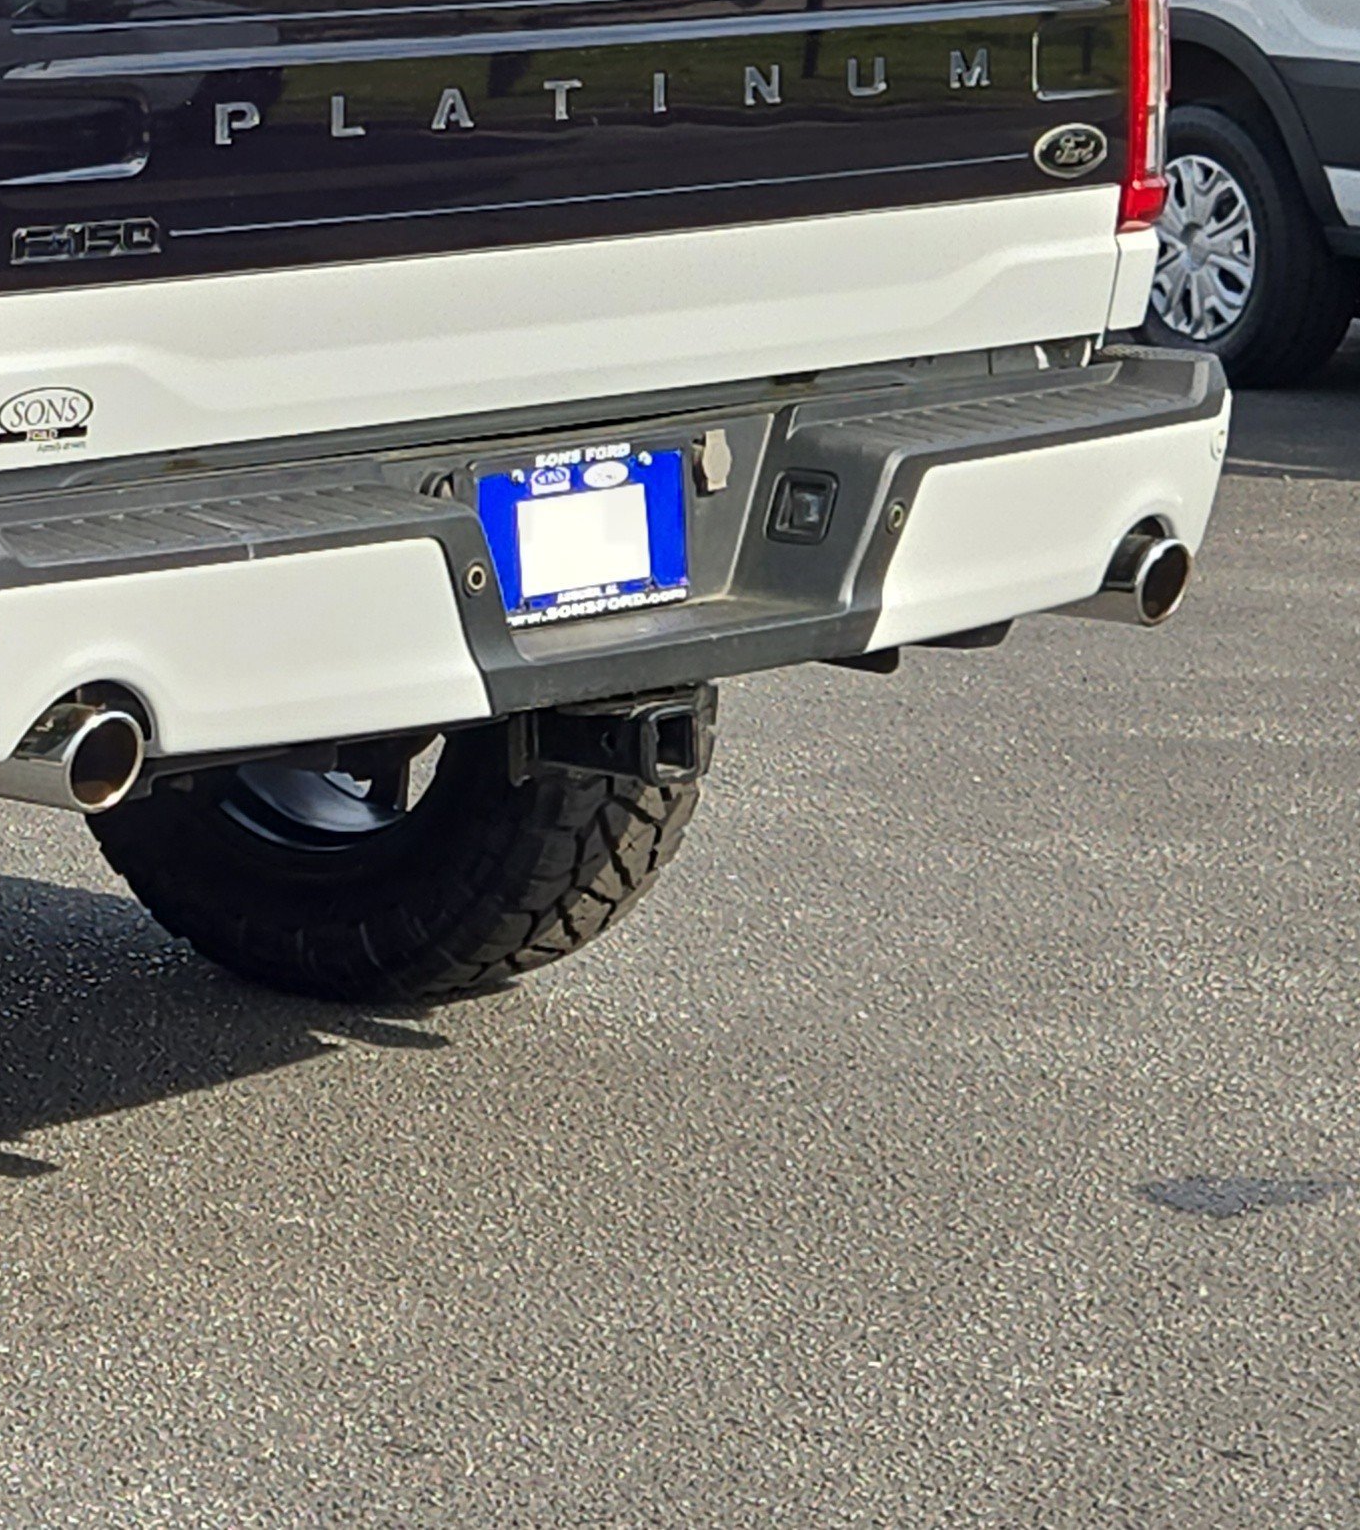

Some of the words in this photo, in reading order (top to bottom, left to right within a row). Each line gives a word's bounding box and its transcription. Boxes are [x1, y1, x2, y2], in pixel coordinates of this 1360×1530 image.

[214, 48, 991, 146] PLATINUM
[10, 396, 81, 428] SONS
[535, 449, 581, 468] SONS
[585, 442, 631, 461] FORD
